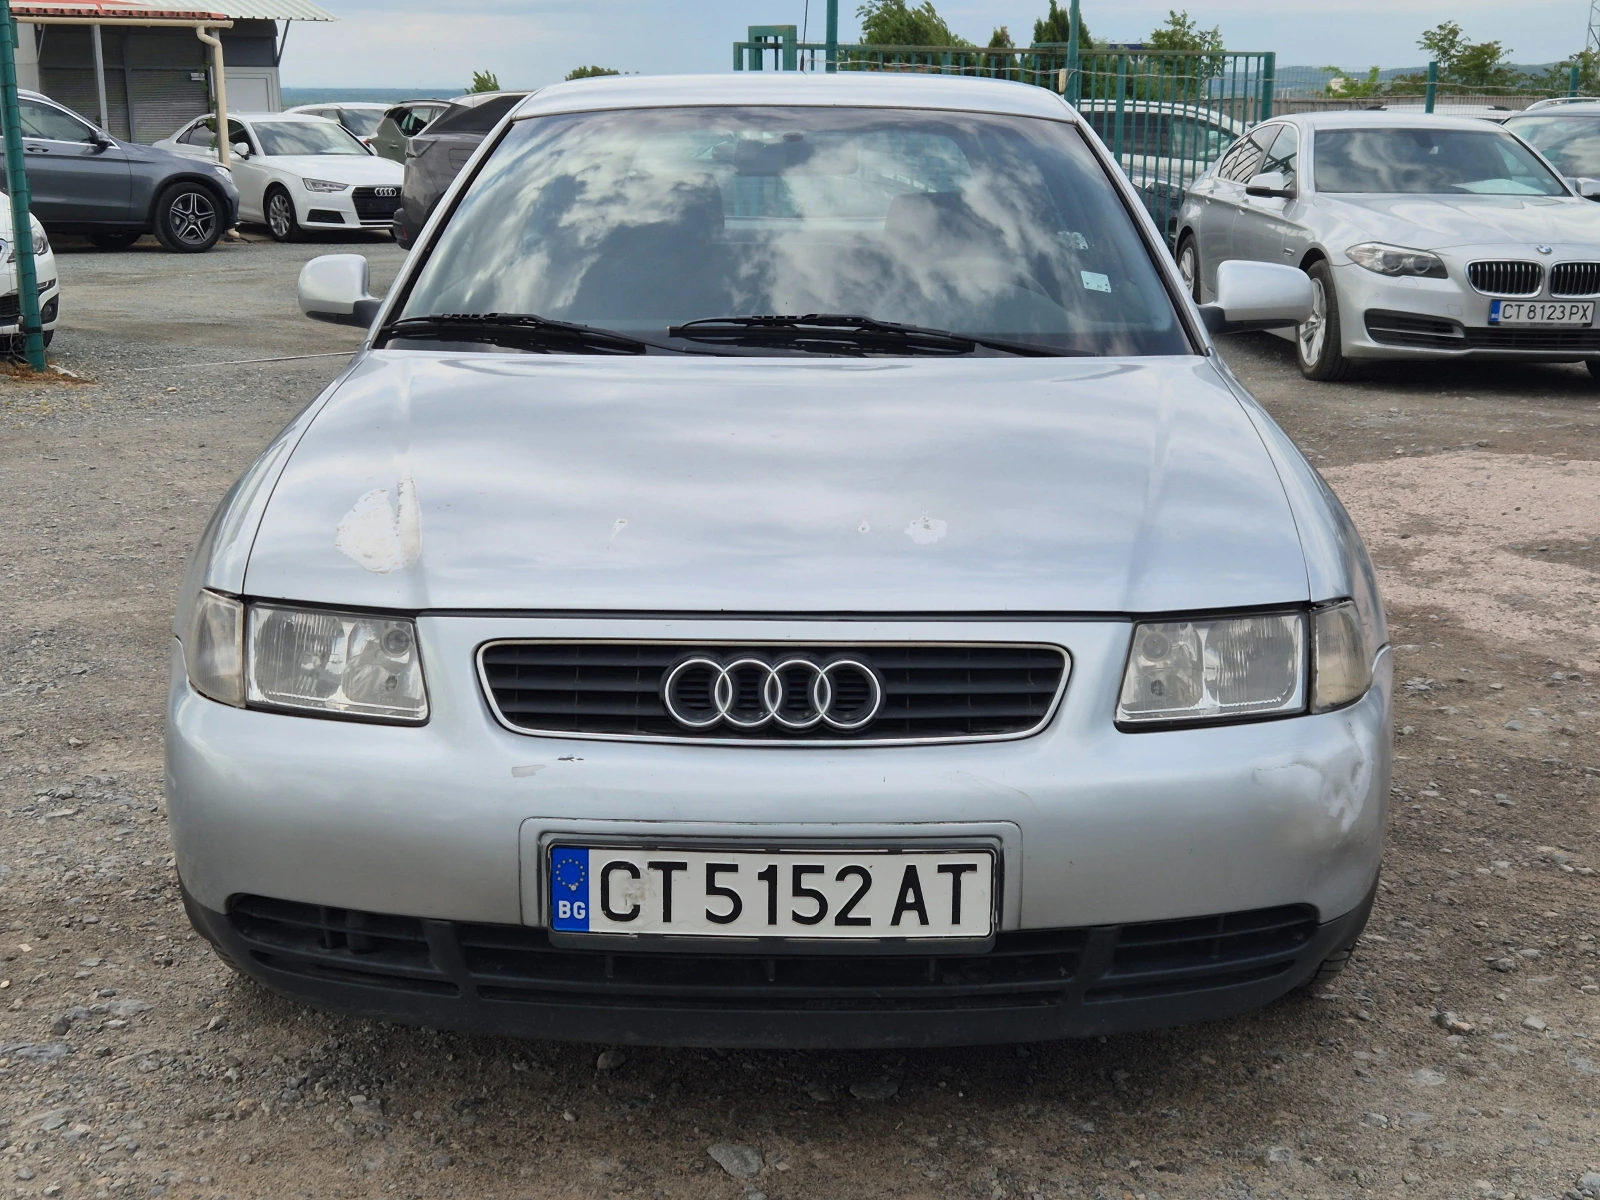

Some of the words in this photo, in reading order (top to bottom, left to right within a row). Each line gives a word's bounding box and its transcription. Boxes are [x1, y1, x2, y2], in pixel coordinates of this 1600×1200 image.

[1502, 304, 1524, 319] CT
[1527, 304, 1566, 320] 8123
[1568, 305, 1590, 321] PX
[600, 861, 688, 923] CT
[705, 863, 872, 926] 5152
[890, 864, 978, 926] AT
[558, 900, 586, 919] BG
